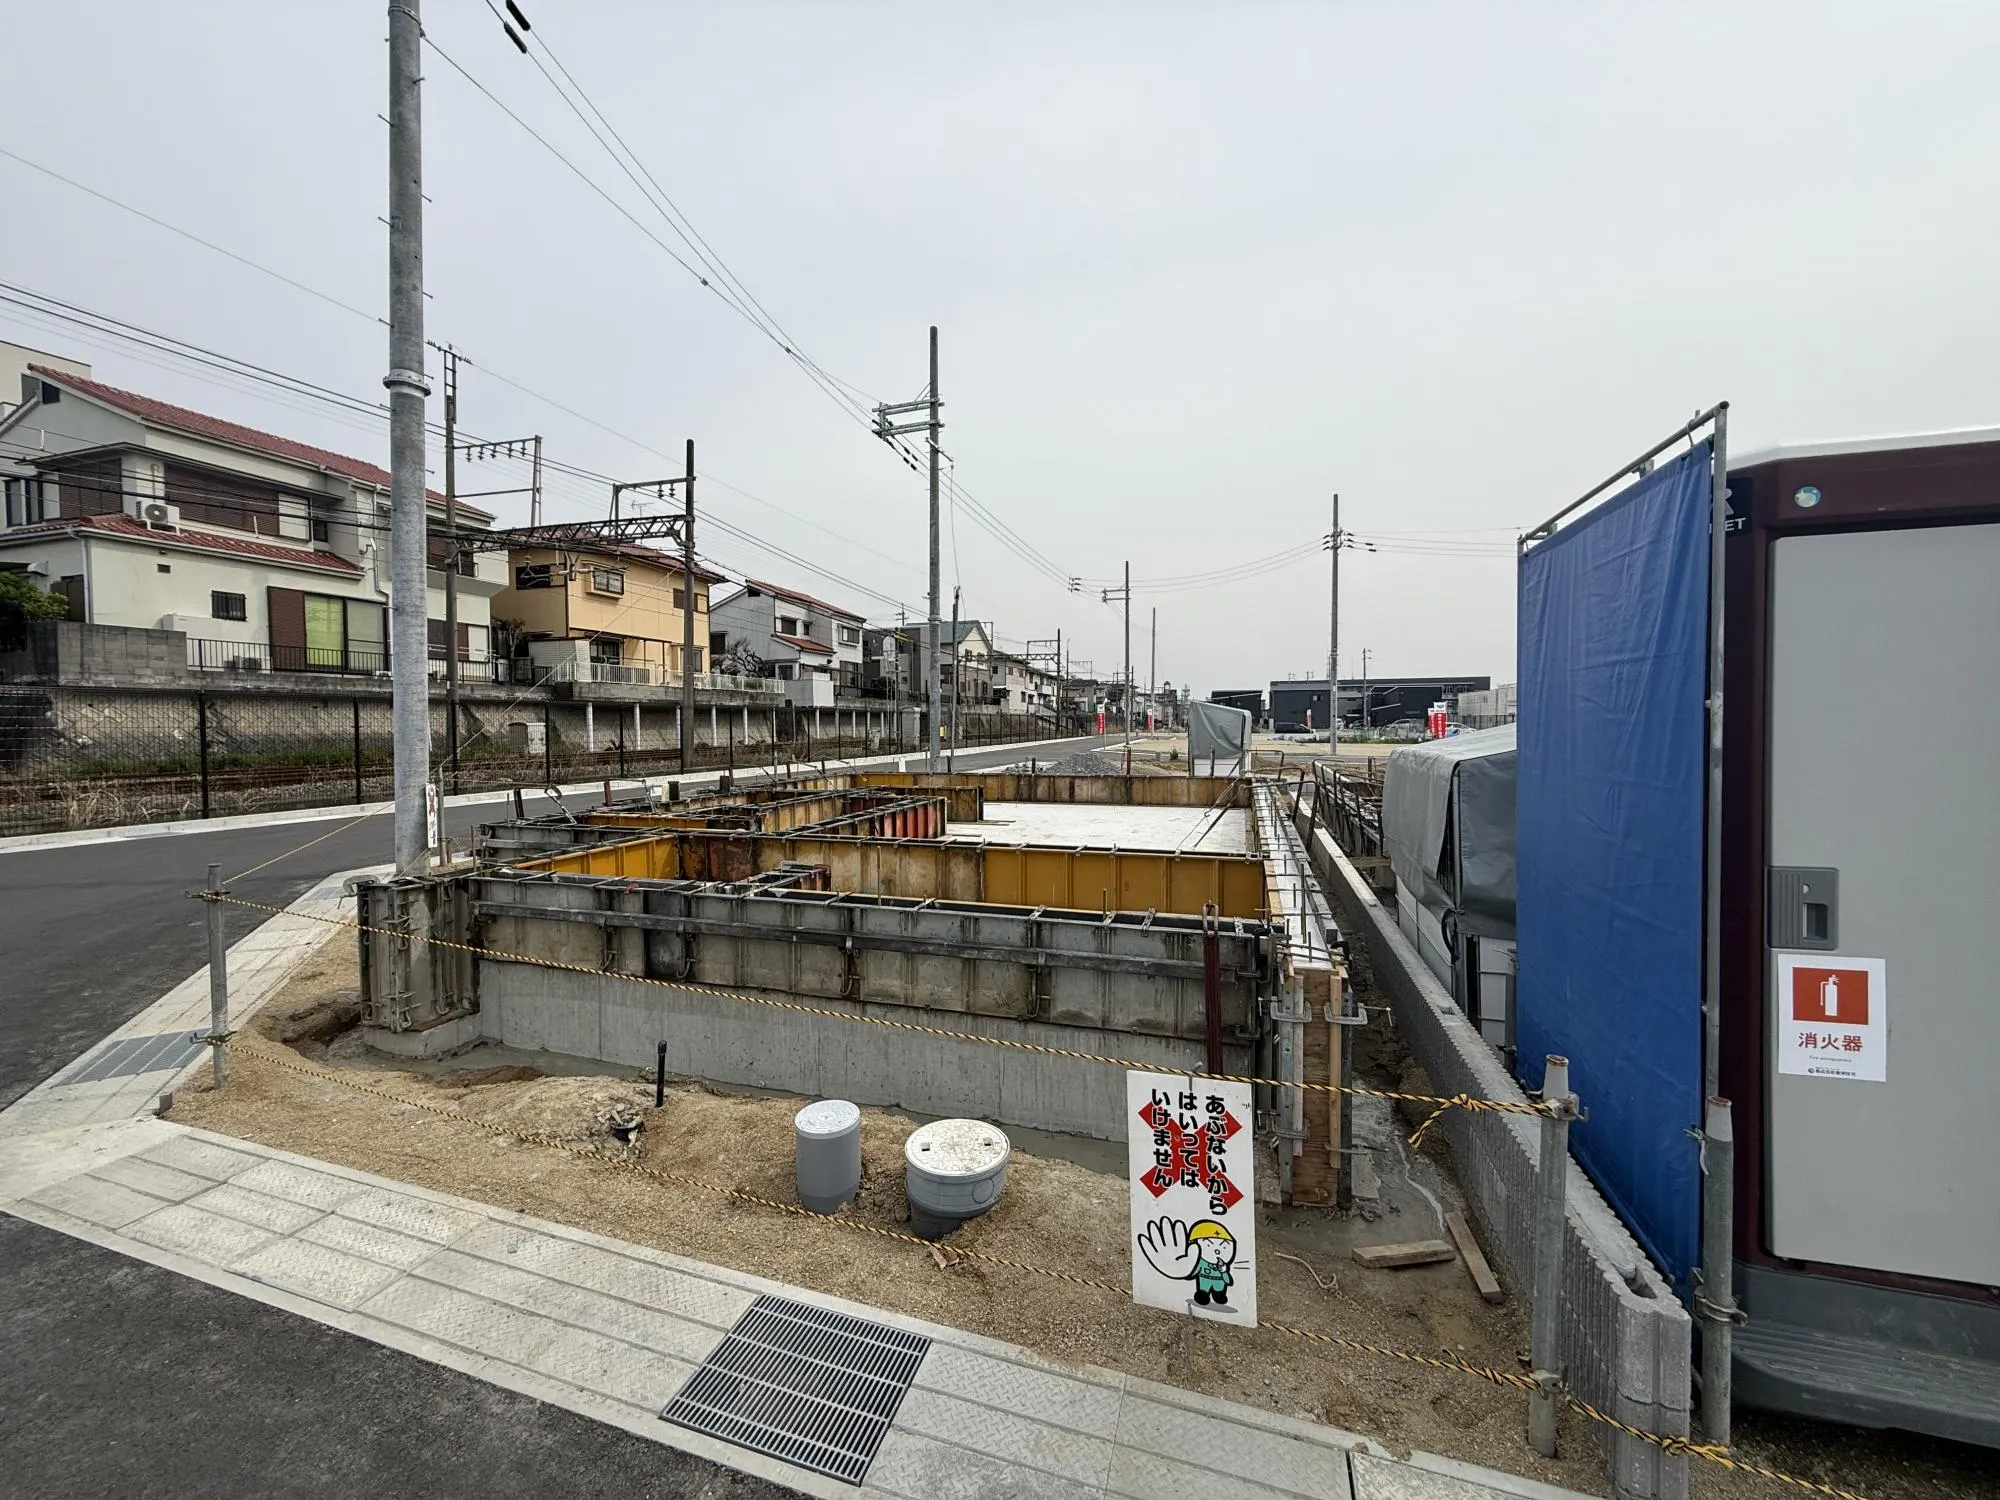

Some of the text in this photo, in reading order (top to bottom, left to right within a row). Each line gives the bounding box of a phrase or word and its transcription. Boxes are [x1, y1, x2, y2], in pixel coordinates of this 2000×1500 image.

[1798, 1032, 1863, 1052] 消火器
[1151, 1088, 1174, 1188] いけません
[1178, 1091, 1200, 1188] はいっては
[1205, 1095, 1228, 1216] あぶないから
